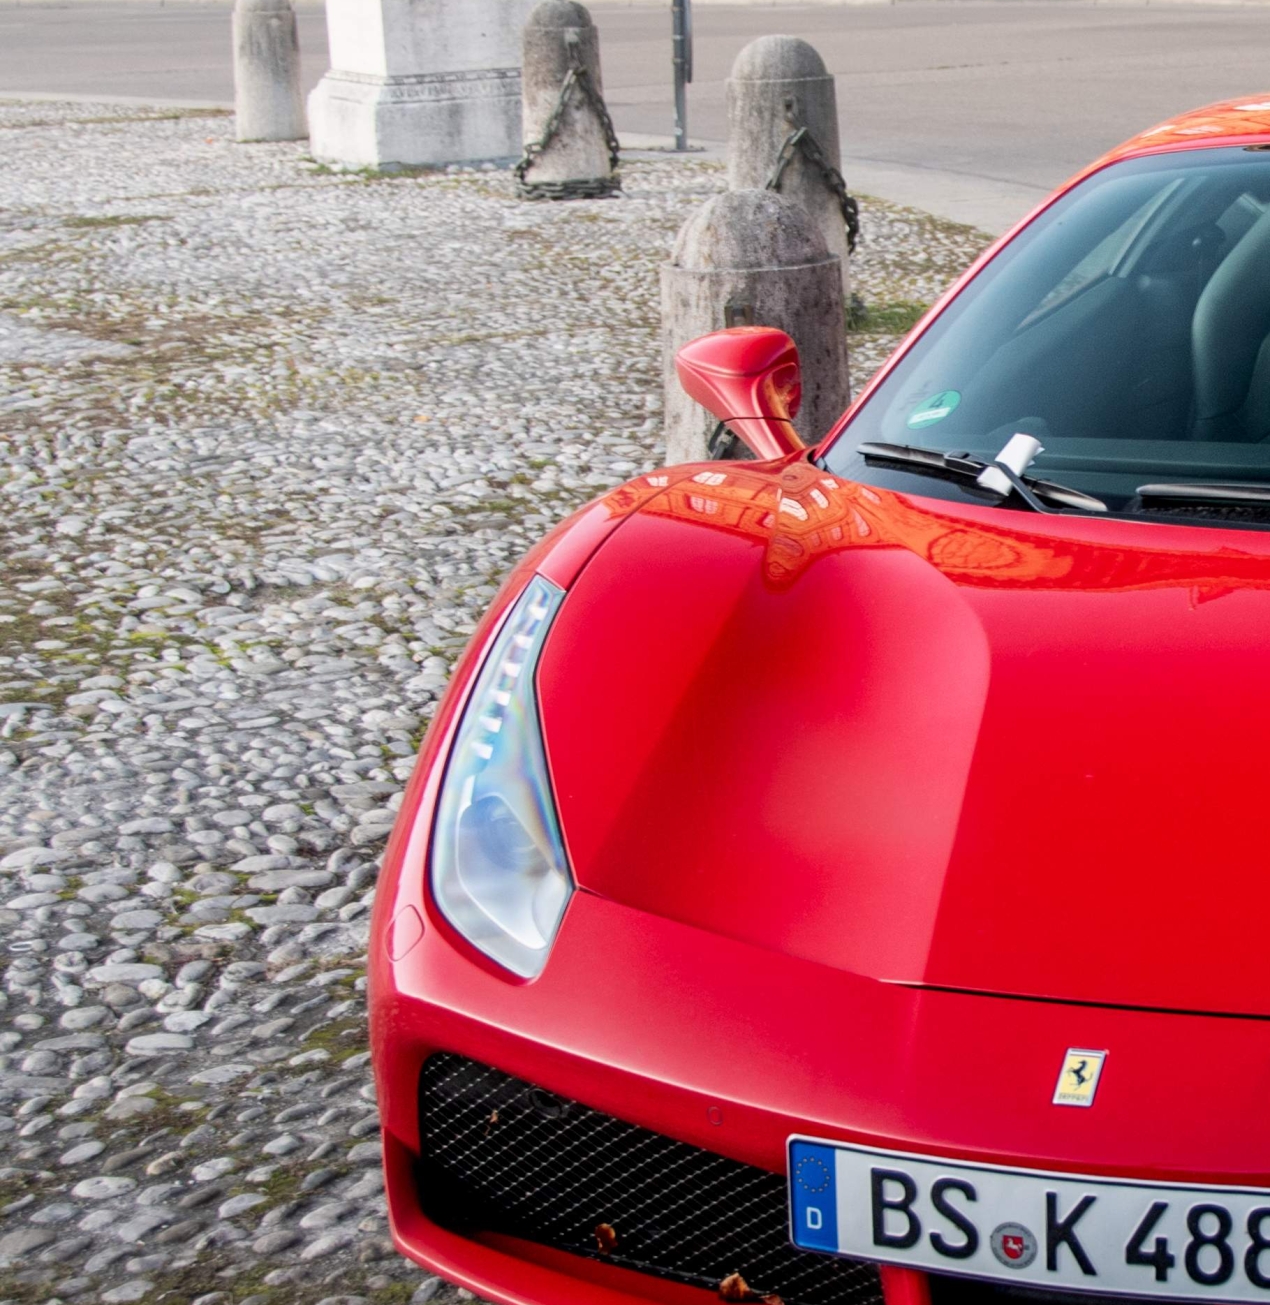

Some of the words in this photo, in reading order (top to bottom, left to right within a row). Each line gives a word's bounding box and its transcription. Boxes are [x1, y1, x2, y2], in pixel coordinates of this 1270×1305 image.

[806, 1206, 823, 1230] D
[870, 1167, 980, 1259] BS
[1045, 1191, 1097, 1277] K
